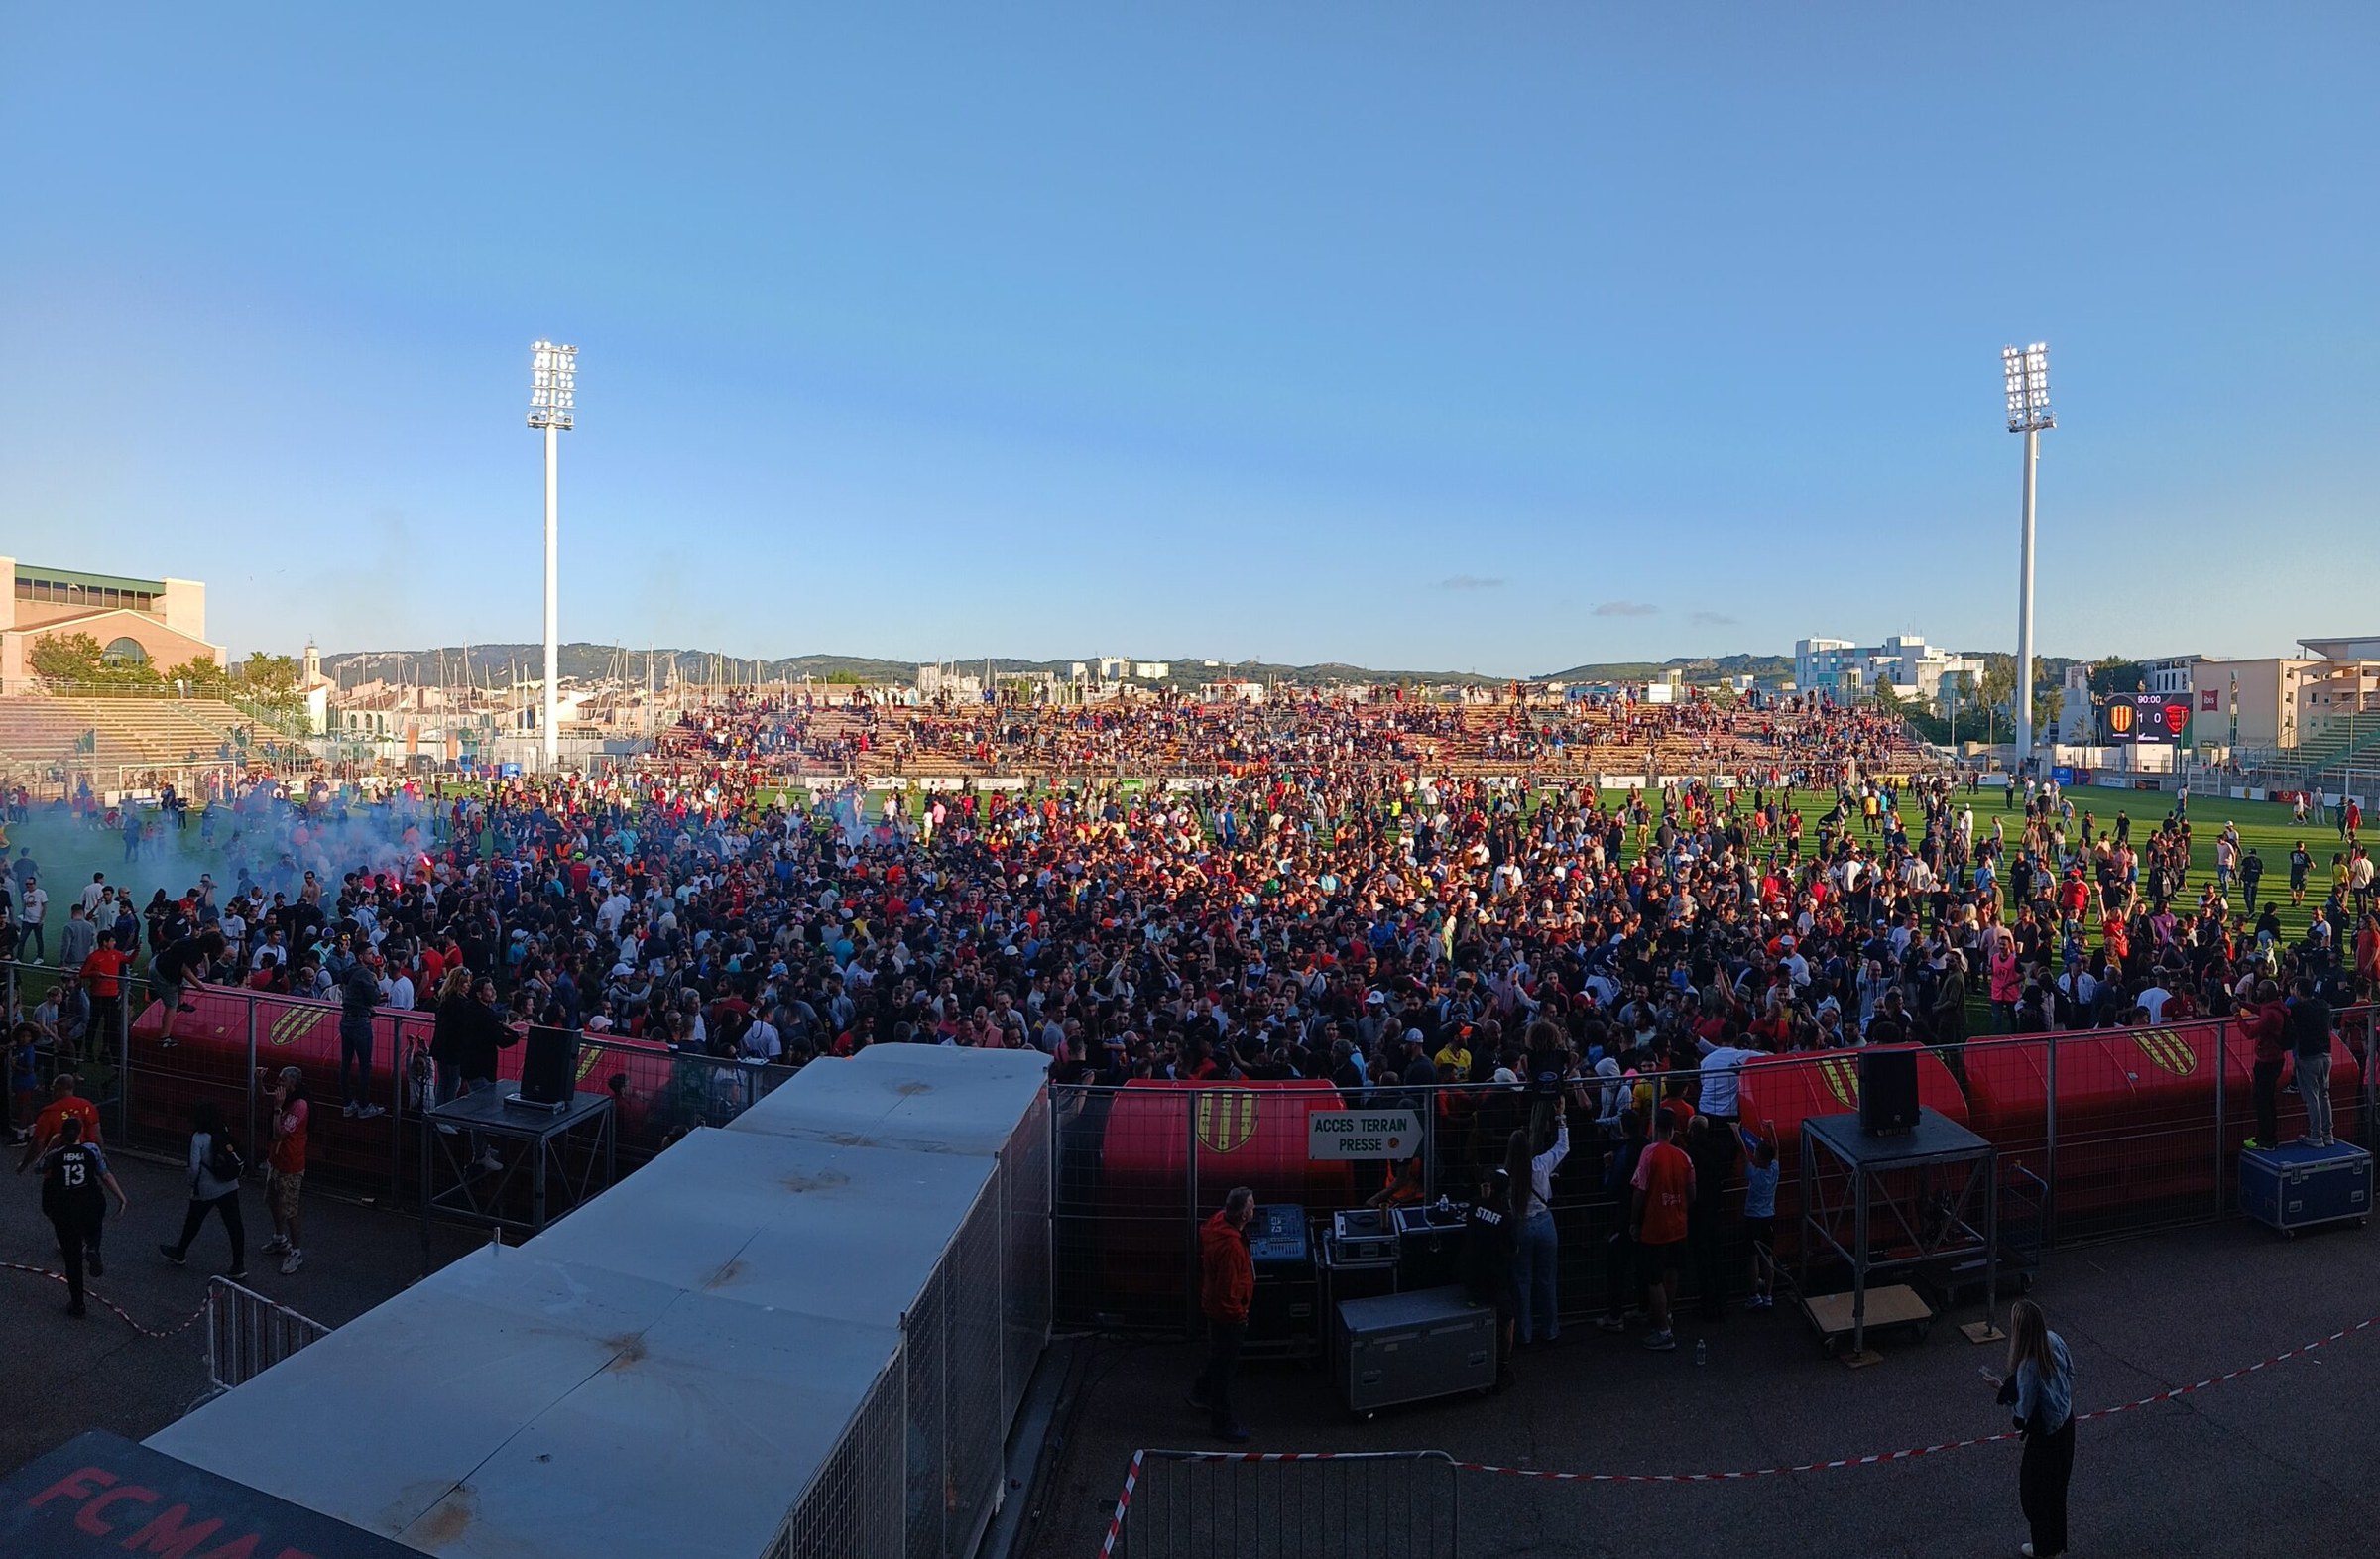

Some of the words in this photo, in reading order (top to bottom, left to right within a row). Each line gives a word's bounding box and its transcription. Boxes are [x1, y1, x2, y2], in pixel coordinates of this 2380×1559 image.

[2138, 695, 2161, 704] 90:00
[2203, 695, 2214, 705] ibis
[2154, 713, 2162, 723] 0
[1315, 1119, 1354, 1132] ACCES
[1361, 1118, 1407, 1132] TERRAIN
[1339, 1138, 1382, 1151] PRESSE
[62, 1163, 85, 1187] 13
[1475, 1206, 1503, 1226] STAFF
[29, 1466, 316, 1559] FCMA
